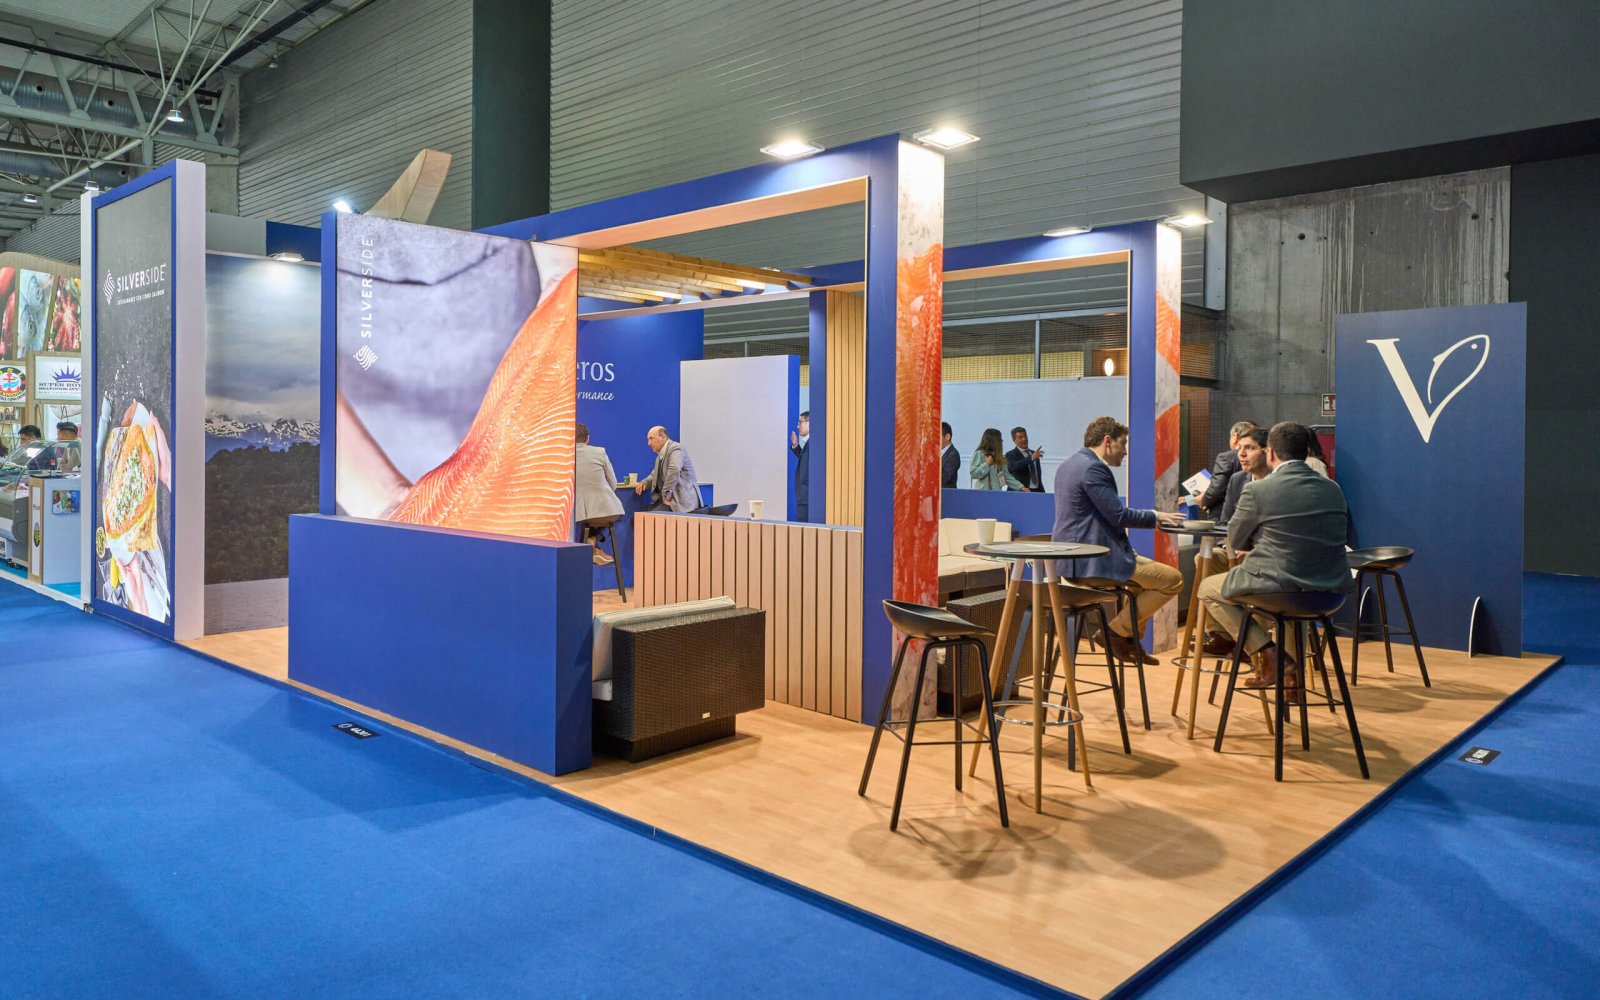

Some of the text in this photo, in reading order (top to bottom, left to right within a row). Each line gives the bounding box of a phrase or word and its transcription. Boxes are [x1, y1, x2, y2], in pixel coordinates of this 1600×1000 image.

[117, 264, 166, 292] SILVERSIDE
[361, 236, 373, 338] SILVERSIDE
[576, 361, 615, 382] ros
